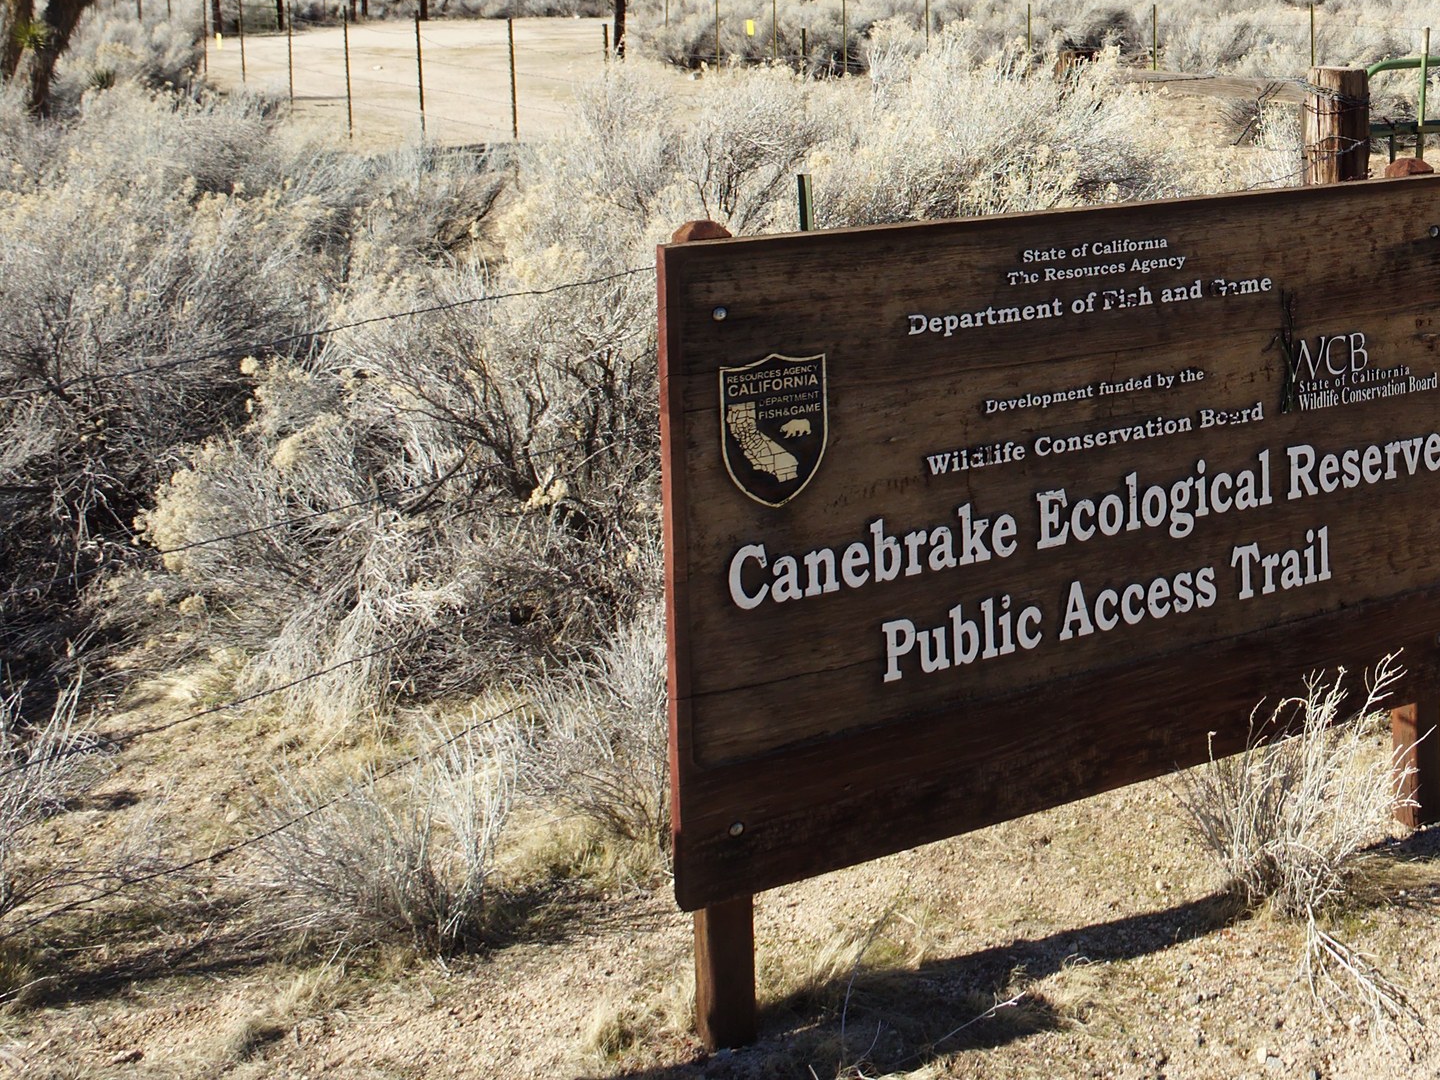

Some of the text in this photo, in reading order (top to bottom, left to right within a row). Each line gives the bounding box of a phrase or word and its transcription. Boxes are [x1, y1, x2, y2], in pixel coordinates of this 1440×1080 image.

[1022, 238, 1168, 263] State of California
[1007, 256, 1186, 286] The Resources Agency
[908, 297, 1063, 337] Department
[1071, 291, 1097, 315] of
[1102, 285, 1154, 311] Fish
[1161, 280, 1203, 303] and
[726, 364, 819, 384] RESOURCES AGENCY
[727, 373, 819, 397] CALIFORNIA
[1299, 365, 1410, 394] State of California
[759, 390, 820, 407] DEPARTMENT
[985, 369, 1205, 414] Development funded by the
[1298, 372, 1438, 412] Wildlife Conservation Board
[758, 402, 821, 420] FISH&GAME
[926, 401, 1264, 476] Wildlife Conservation Board
[728, 503, 1019, 611] Canebrake
[1036, 451, 1273, 549] Ecological
[882, 526, 1332, 683] Public Access Trail
